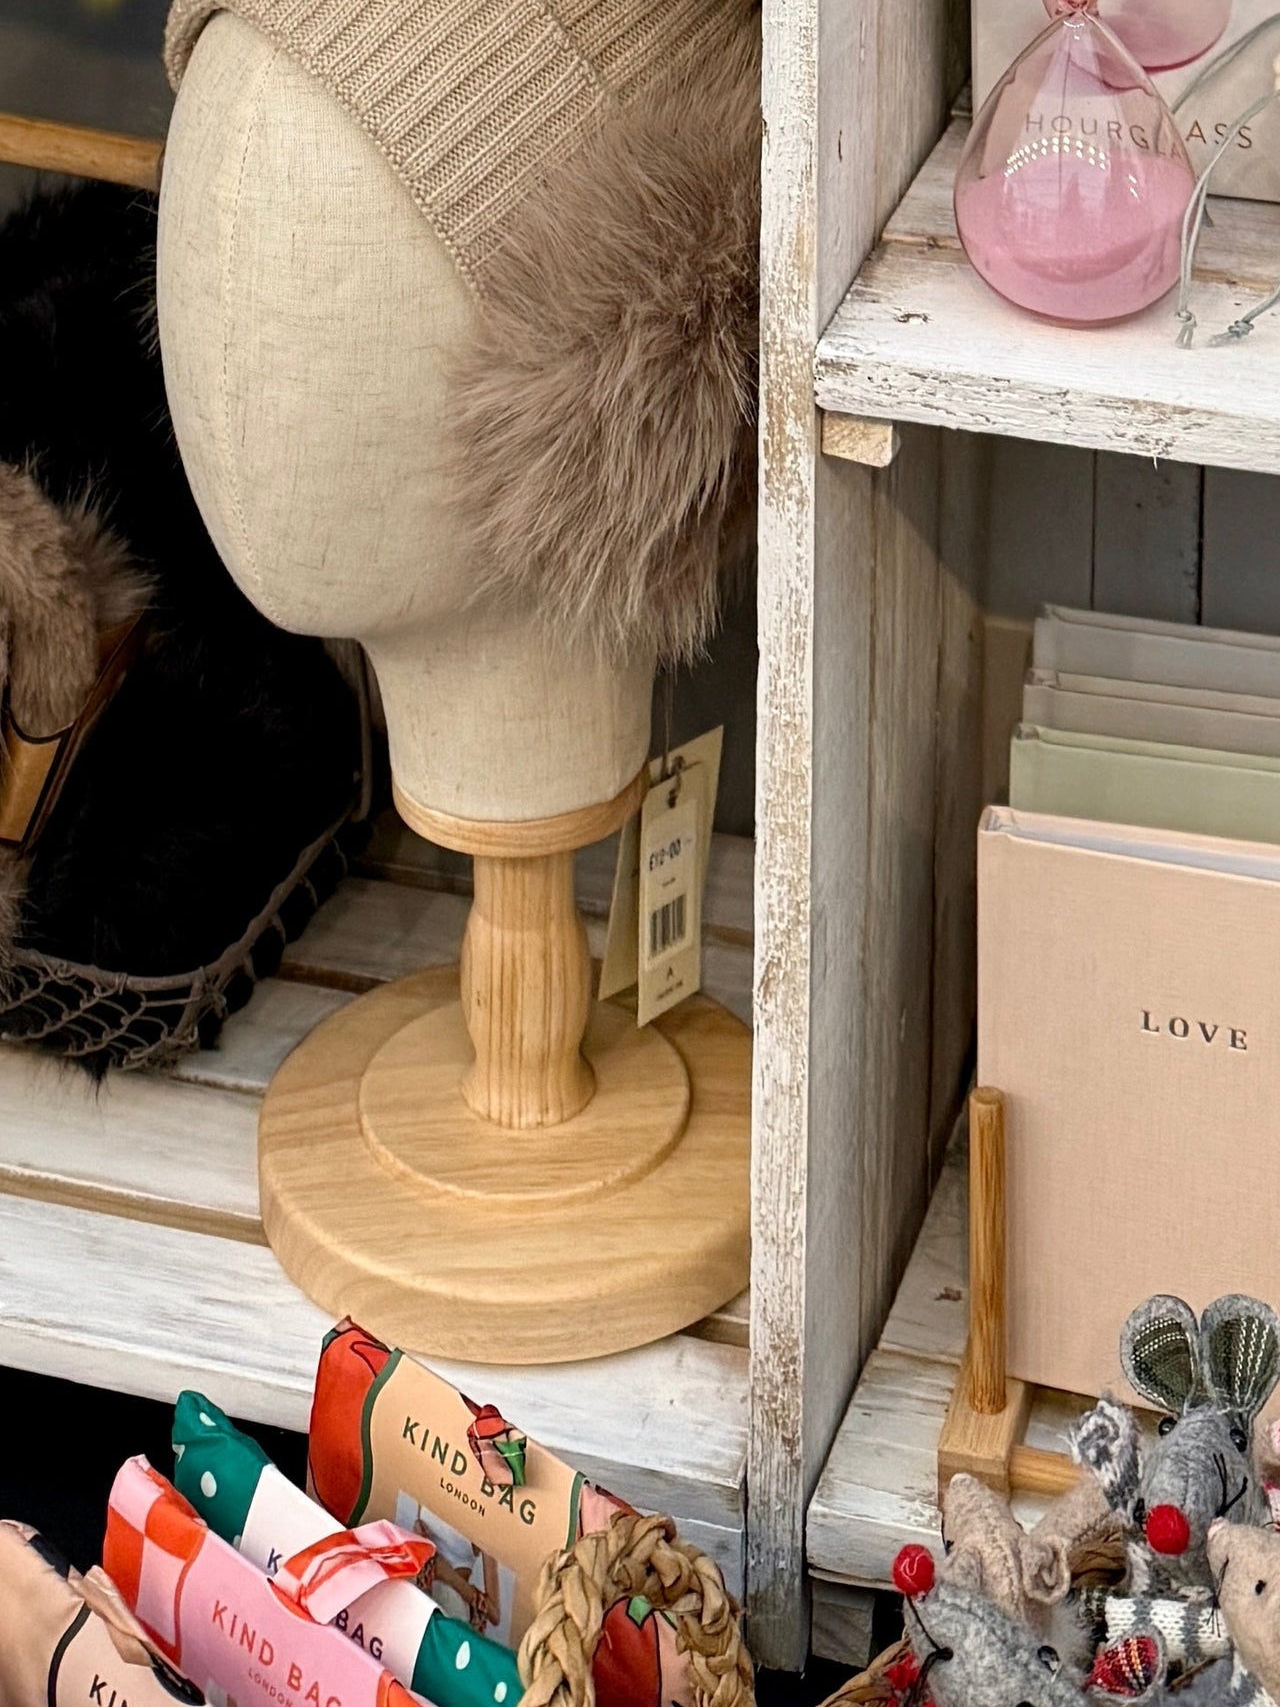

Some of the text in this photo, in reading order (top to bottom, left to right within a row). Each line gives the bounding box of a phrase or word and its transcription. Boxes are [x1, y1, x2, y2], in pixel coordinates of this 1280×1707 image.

[1141, 1009, 1247, 1050] LOVE
[402, 1416, 467, 1476] KIND
[440, 1477, 486, 1517] LONDON
[212, 1599, 274, 1667] KIND
[335, 1608, 384, 1661] BAG
